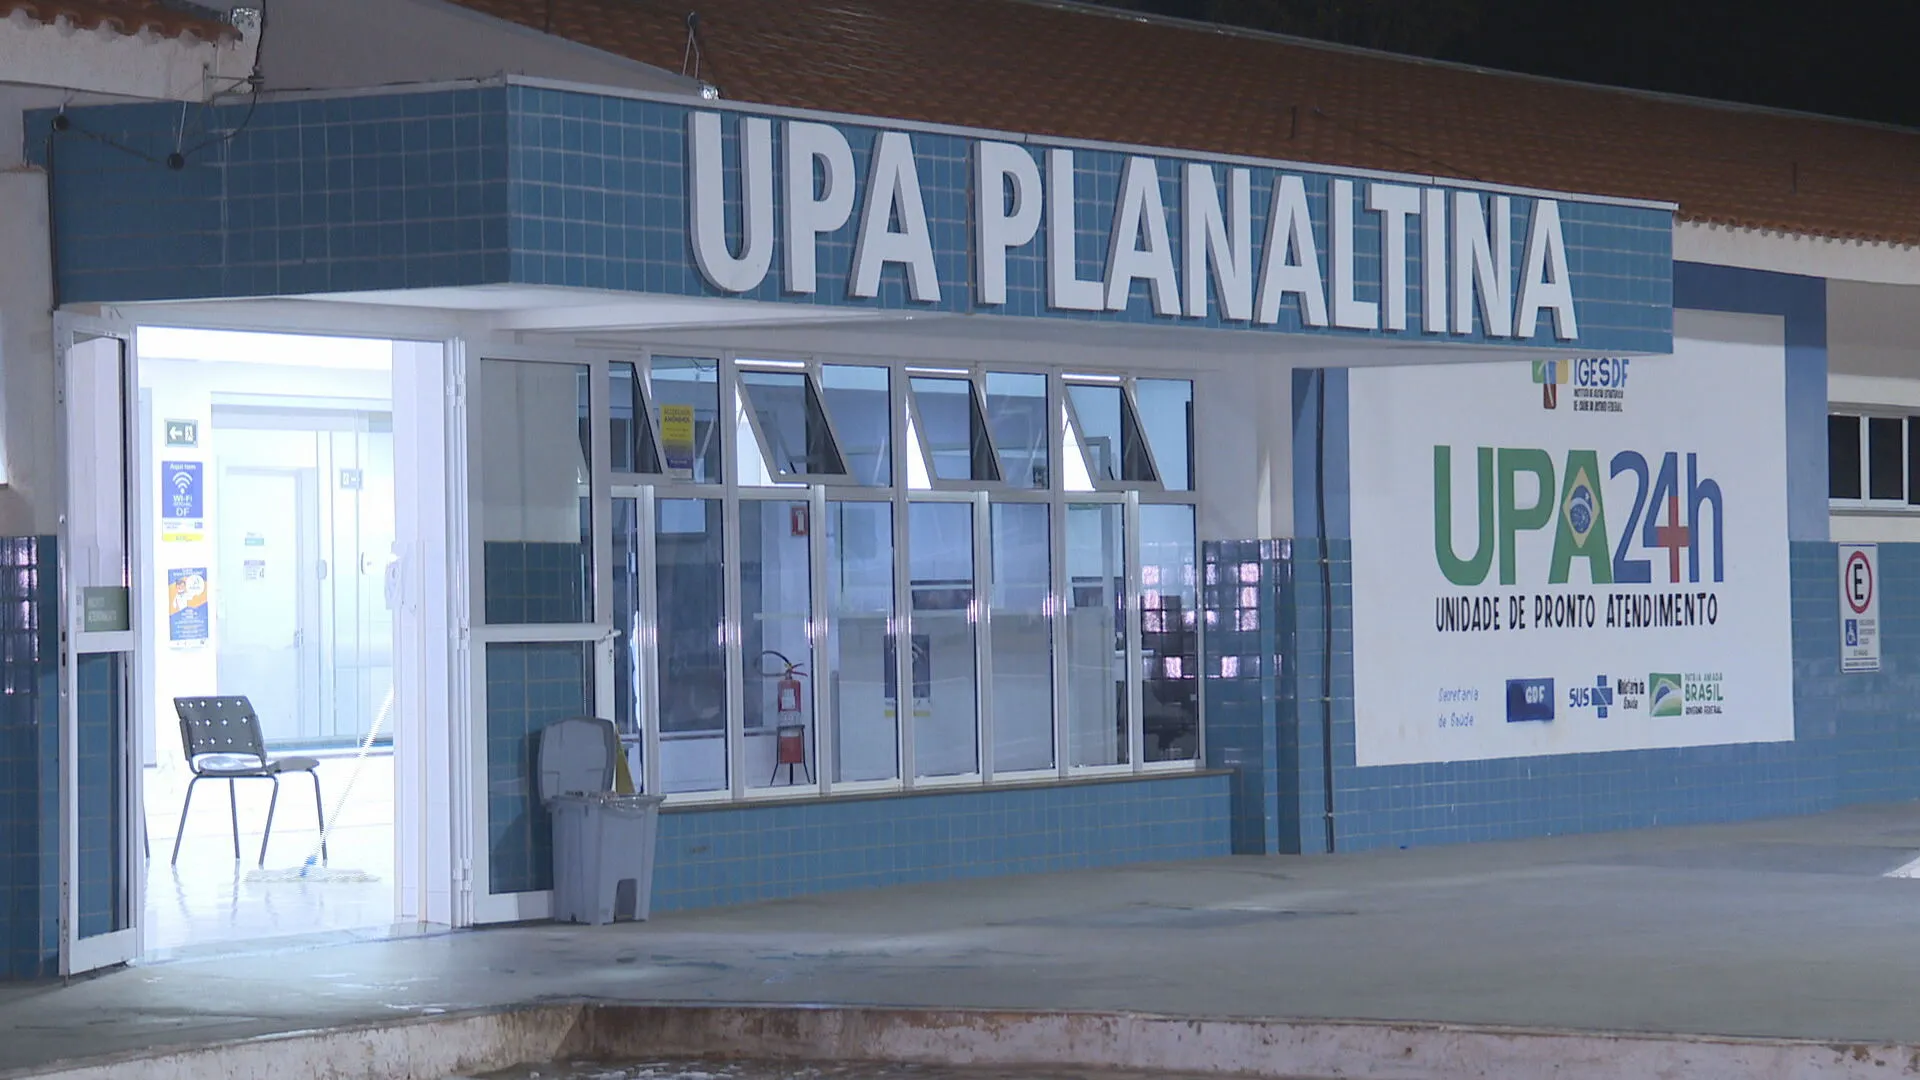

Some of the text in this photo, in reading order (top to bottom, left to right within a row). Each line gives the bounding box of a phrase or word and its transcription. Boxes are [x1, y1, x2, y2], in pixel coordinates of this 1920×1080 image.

[689, 111, 1579, 341] UPA PLANALTINA
[1573, 357, 1629, 388] IGESDF
[1853, 563, 1864, 600] E
[1436, 592, 1718, 632] UNIDADE DE PRONTO ATENDIMENTO
[1525, 685, 1546, 704] GDF
[1569, 687, 1590, 708] SUS
[1685, 683, 1724, 701] BRASIL
[1438, 713, 1447, 728] de
